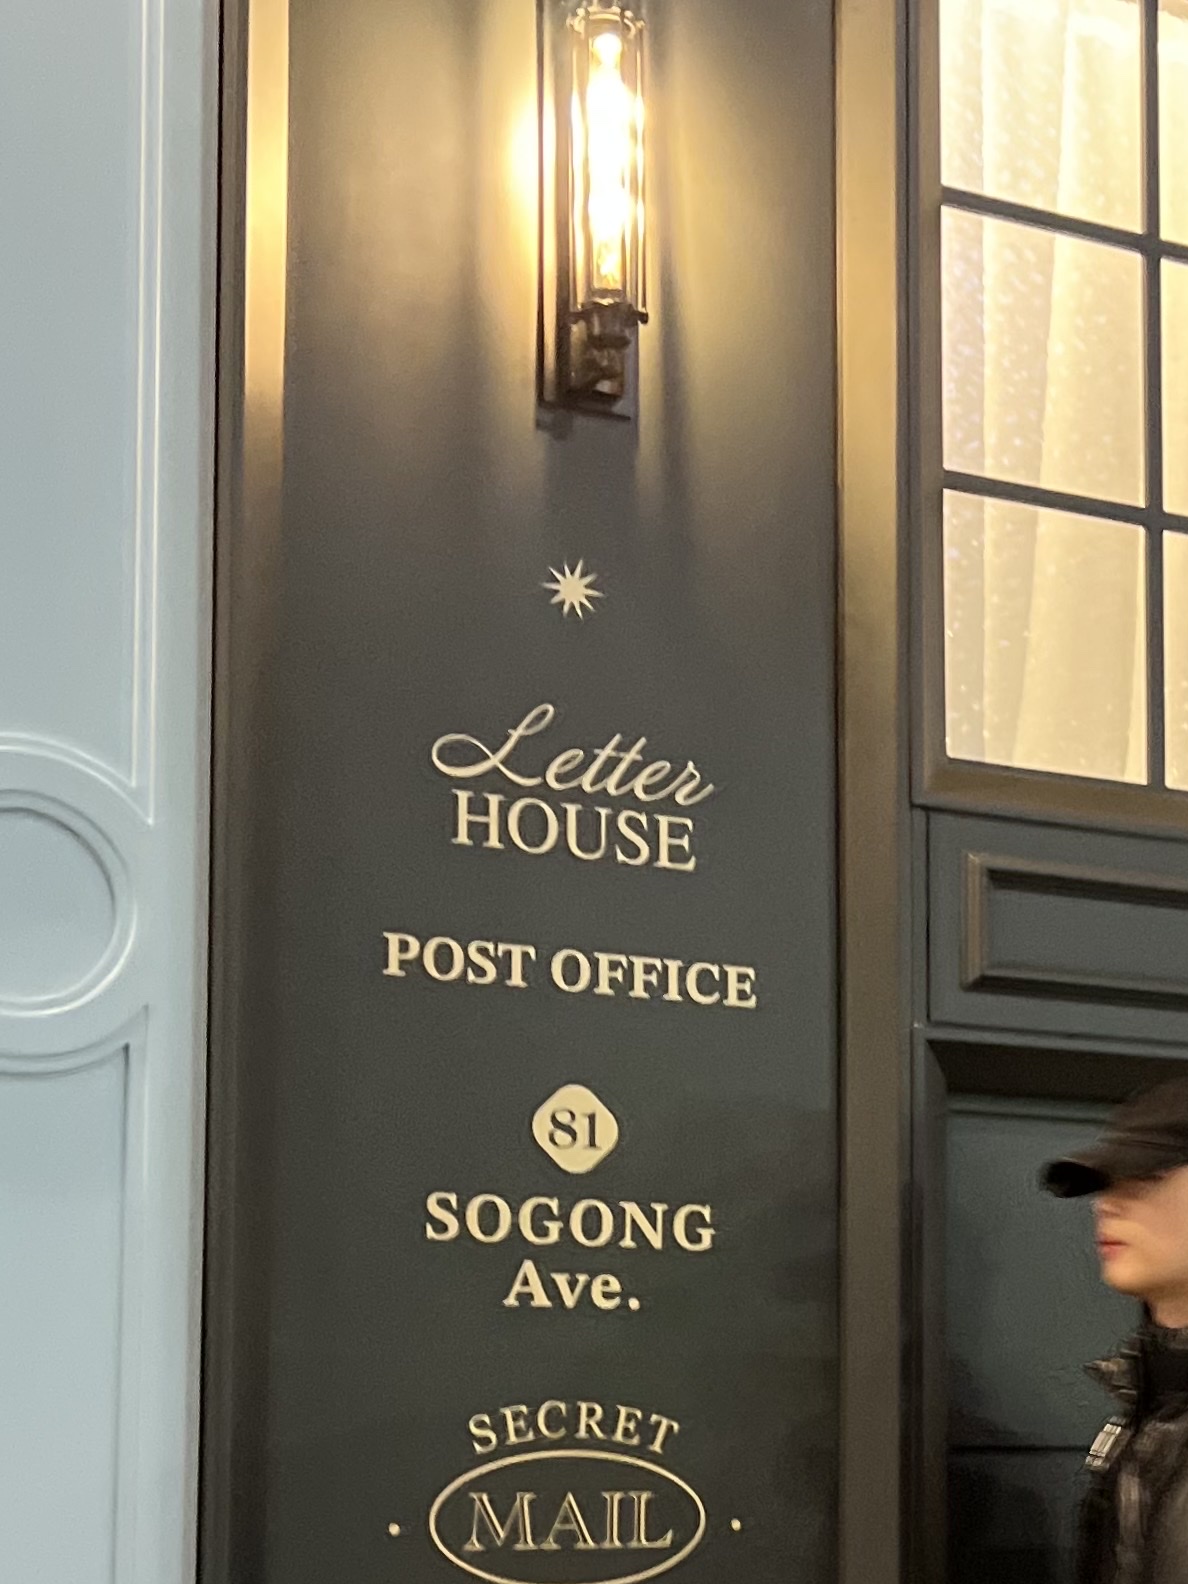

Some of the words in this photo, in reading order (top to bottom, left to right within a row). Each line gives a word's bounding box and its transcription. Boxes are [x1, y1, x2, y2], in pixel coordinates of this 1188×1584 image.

[431, 703, 715, 806] Letter
[451, 788, 697, 871] HOUSE
[382, 931, 536, 988] POST
[550, 948, 758, 1008] OFFICE
[548, 1108, 602, 1150] 81
[424, 1190, 717, 1252] SOGONG
[502, 1258, 641, 1311] Ave.
[467, 1400, 681, 1455] SECRET
[462, 1491, 674, 1552] MAIL
